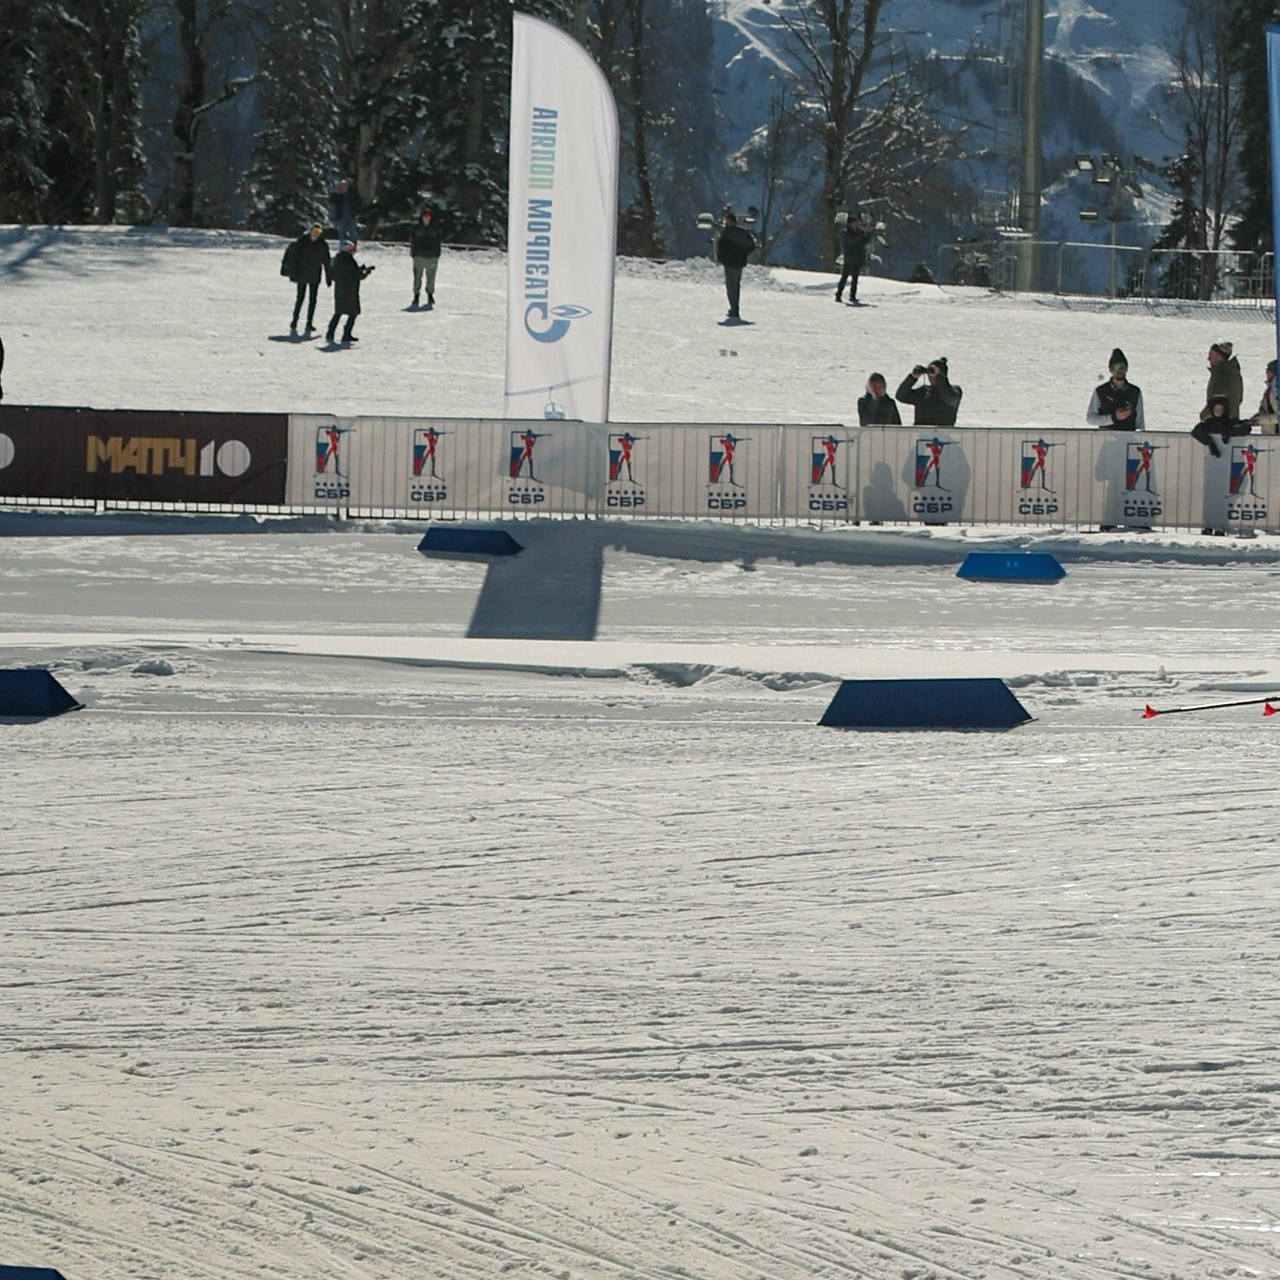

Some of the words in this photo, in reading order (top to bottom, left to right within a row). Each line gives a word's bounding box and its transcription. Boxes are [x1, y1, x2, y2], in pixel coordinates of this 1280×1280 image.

[86, 435, 196, 475] МАТЧ
[315, 488, 350, 499] СБР
[411, 491, 447, 502] СБР
[508, 493, 545, 504] СБР
[607, 496, 645, 507] СБР
[708, 498, 747, 509] СБР
[809, 500, 848, 511] СБР
[913, 503, 952, 514] СБР
[1019, 504, 1058, 515] СБР
[1123, 506, 1163, 517] СБР
[1227, 509, 1267, 521] СБР
